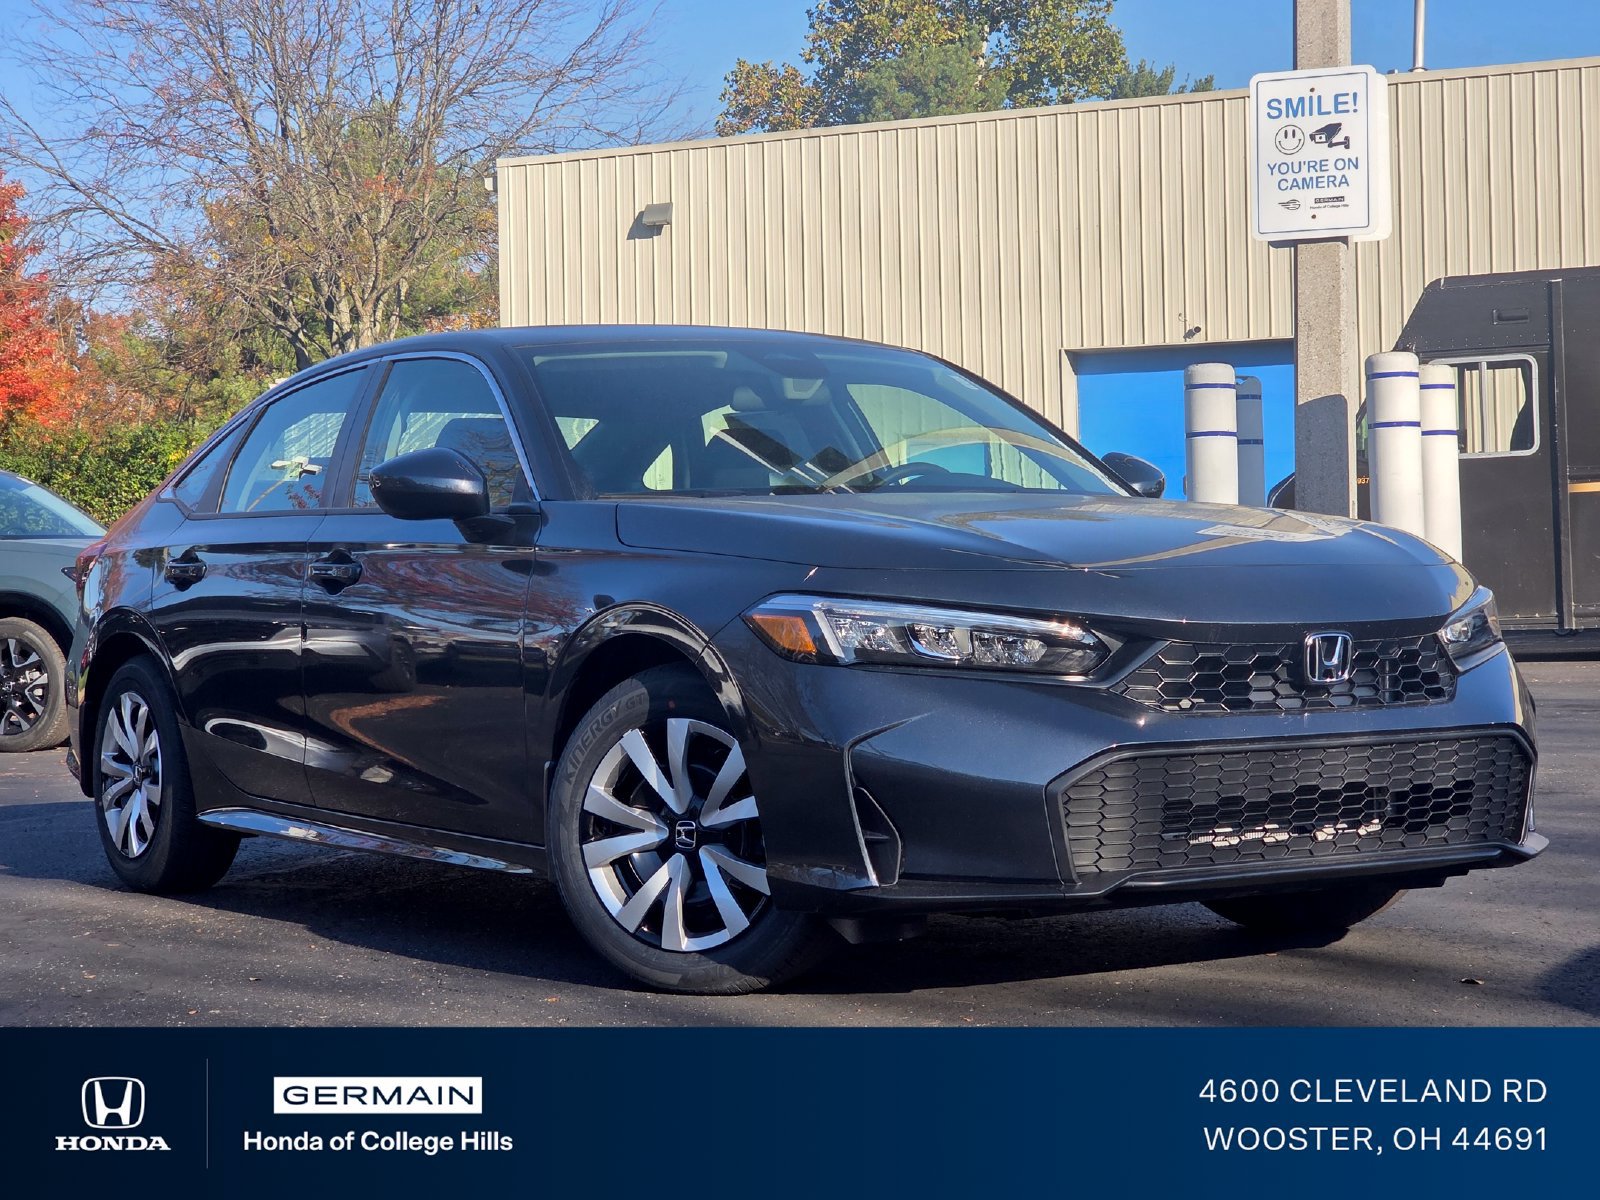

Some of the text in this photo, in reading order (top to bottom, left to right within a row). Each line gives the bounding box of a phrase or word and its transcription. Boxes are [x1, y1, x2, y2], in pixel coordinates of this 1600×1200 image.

[1266, 92, 1359, 120] SMILE!
[1267, 157, 1359, 176] YOU'RE ON
[1277, 175, 1350, 192] CAMERA
[564, 692, 645, 786] KINERGY GT
